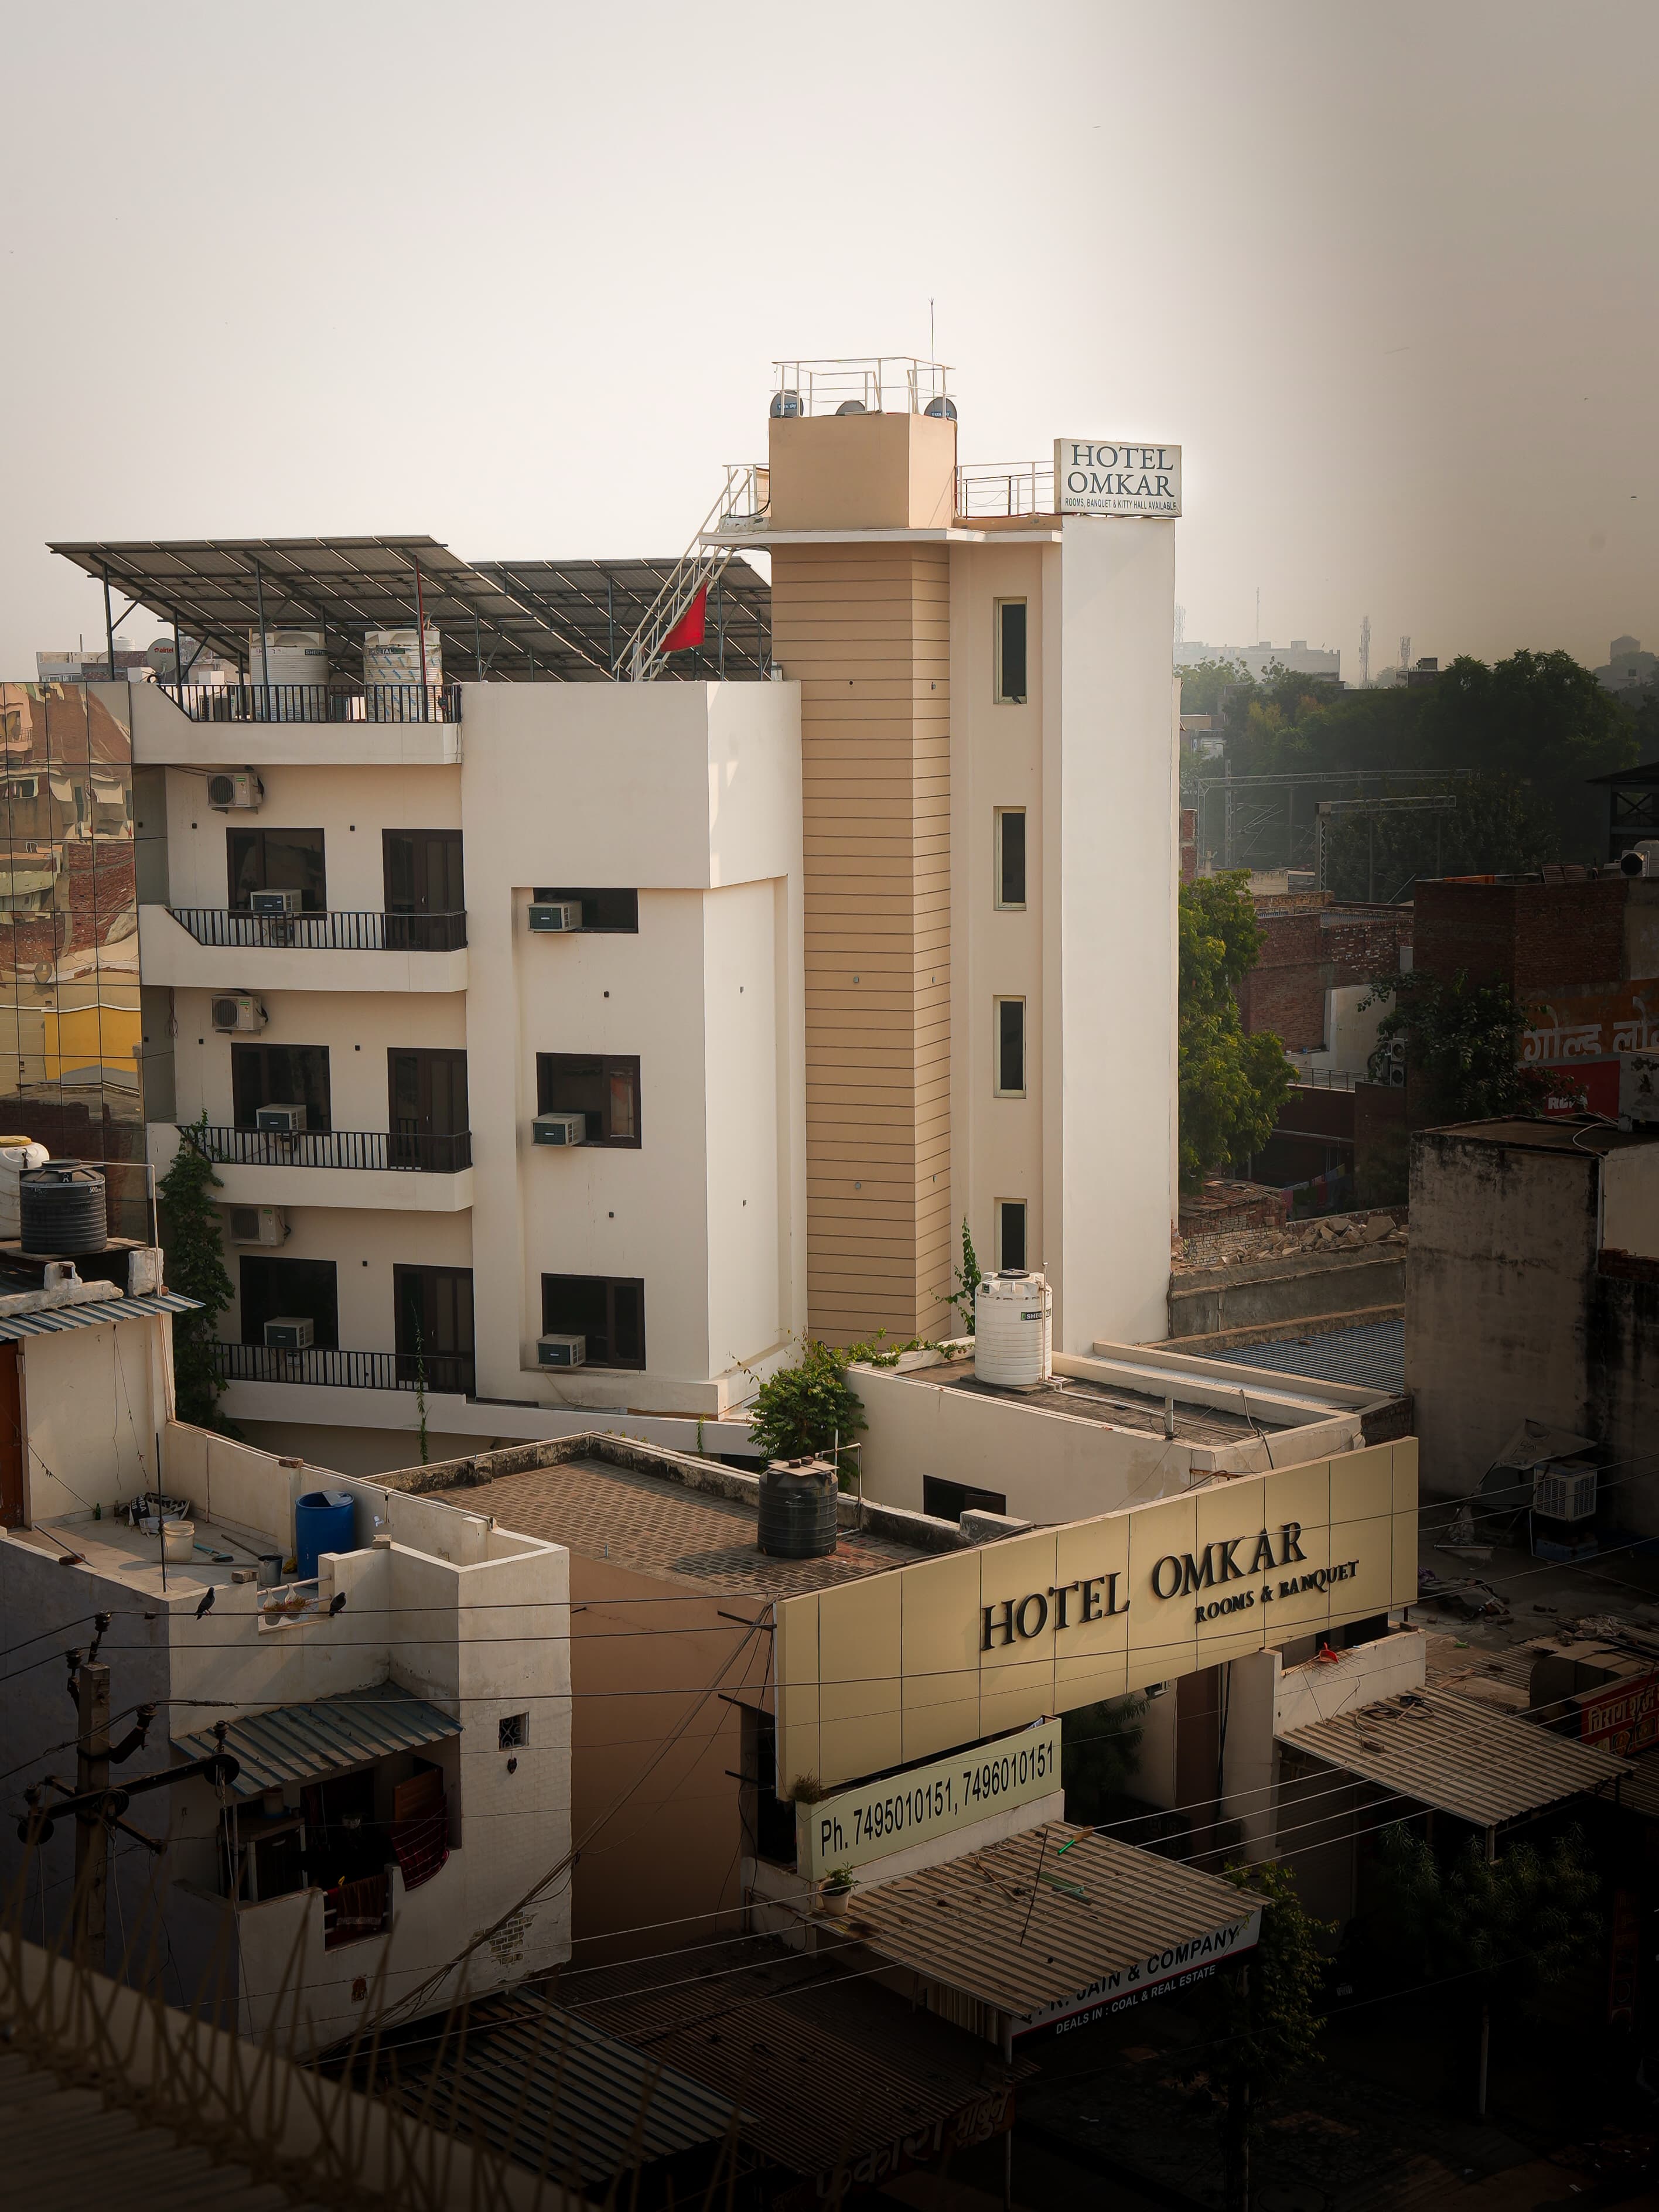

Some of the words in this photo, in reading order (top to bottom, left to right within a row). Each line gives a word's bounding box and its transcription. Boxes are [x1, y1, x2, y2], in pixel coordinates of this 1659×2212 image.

[1067, 471, 1175, 497] OMKAR
[1071, 444, 1174, 470] HOTEL
[1065, 498, 1085, 508] ROOMS,
[1087, 499, 1111, 508] BANQUET
[1113, 499, 1117, 508] &
[1118, 500, 1132, 509] KITTY
[1134, 500, 1147, 510] HALL
[1148, 501, 1176, 511] AVAILABLE
[981, 1571, 1131, 1651] HOTEL
[1152, 1521, 1308, 1600] OMKAR
[1194, 1590, 1255, 1624] ROOMS
[1260, 1585, 1274, 1603] &
[1279, 1559, 1360, 1599] BANQUET
[821, 1817, 848, 1857] Ph.
[854, 1777, 958, 1845] 7495010151,
[962, 1739, 1053, 1807] 7496010151
[1128, 1964, 1140, 1982] &
[1147, 1924, 1239, 1975] COMPANY
[1056, 2013, 1090, 2035] DEALS
[1092, 2006, 1103, 2021] IN
[1111, 1996, 1139, 2013] COAL
[1141, 1991, 1148, 2001] &
[1151, 1981, 1177, 1998] REAL
[1179, 1965, 1216, 1987] ESTATE
